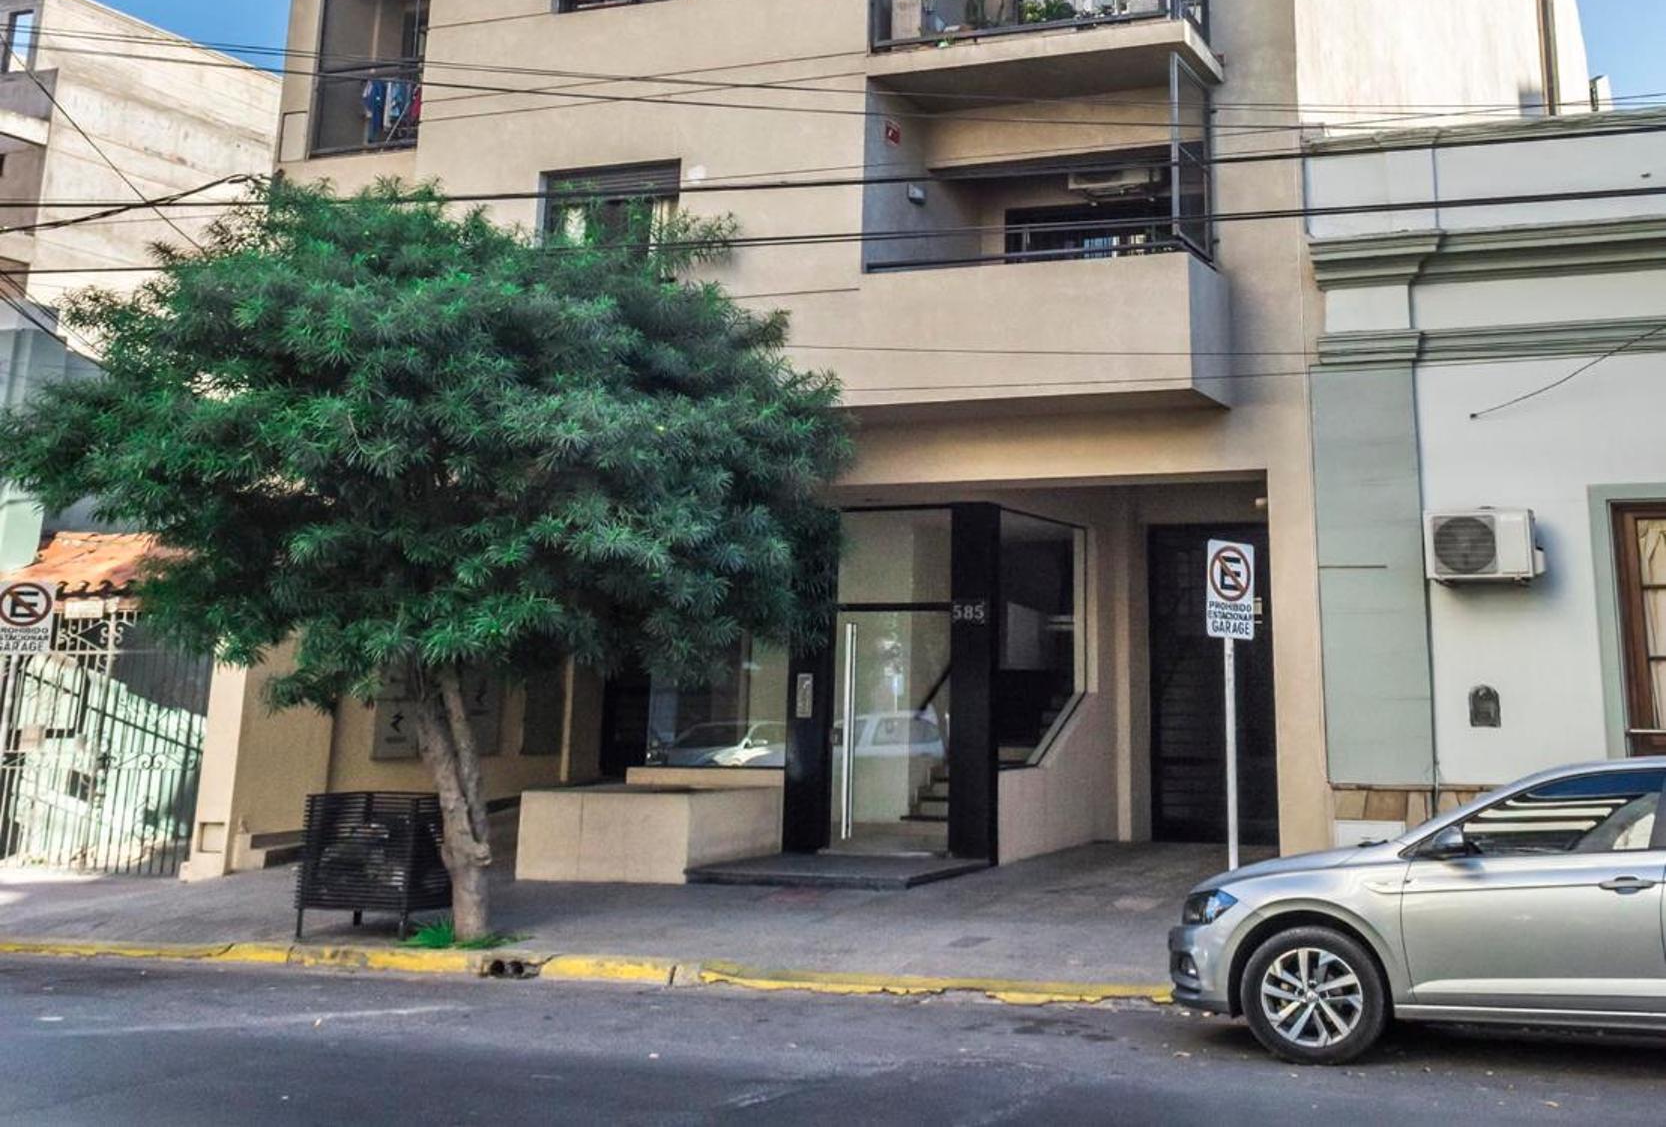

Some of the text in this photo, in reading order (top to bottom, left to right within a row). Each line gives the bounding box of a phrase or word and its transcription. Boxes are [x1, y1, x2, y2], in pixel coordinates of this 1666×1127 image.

[953, 604, 984, 621] 585
[1208, 601, 1252, 612] PROHIBIDO
[1211, 620, 1250, 636] GARAGE
